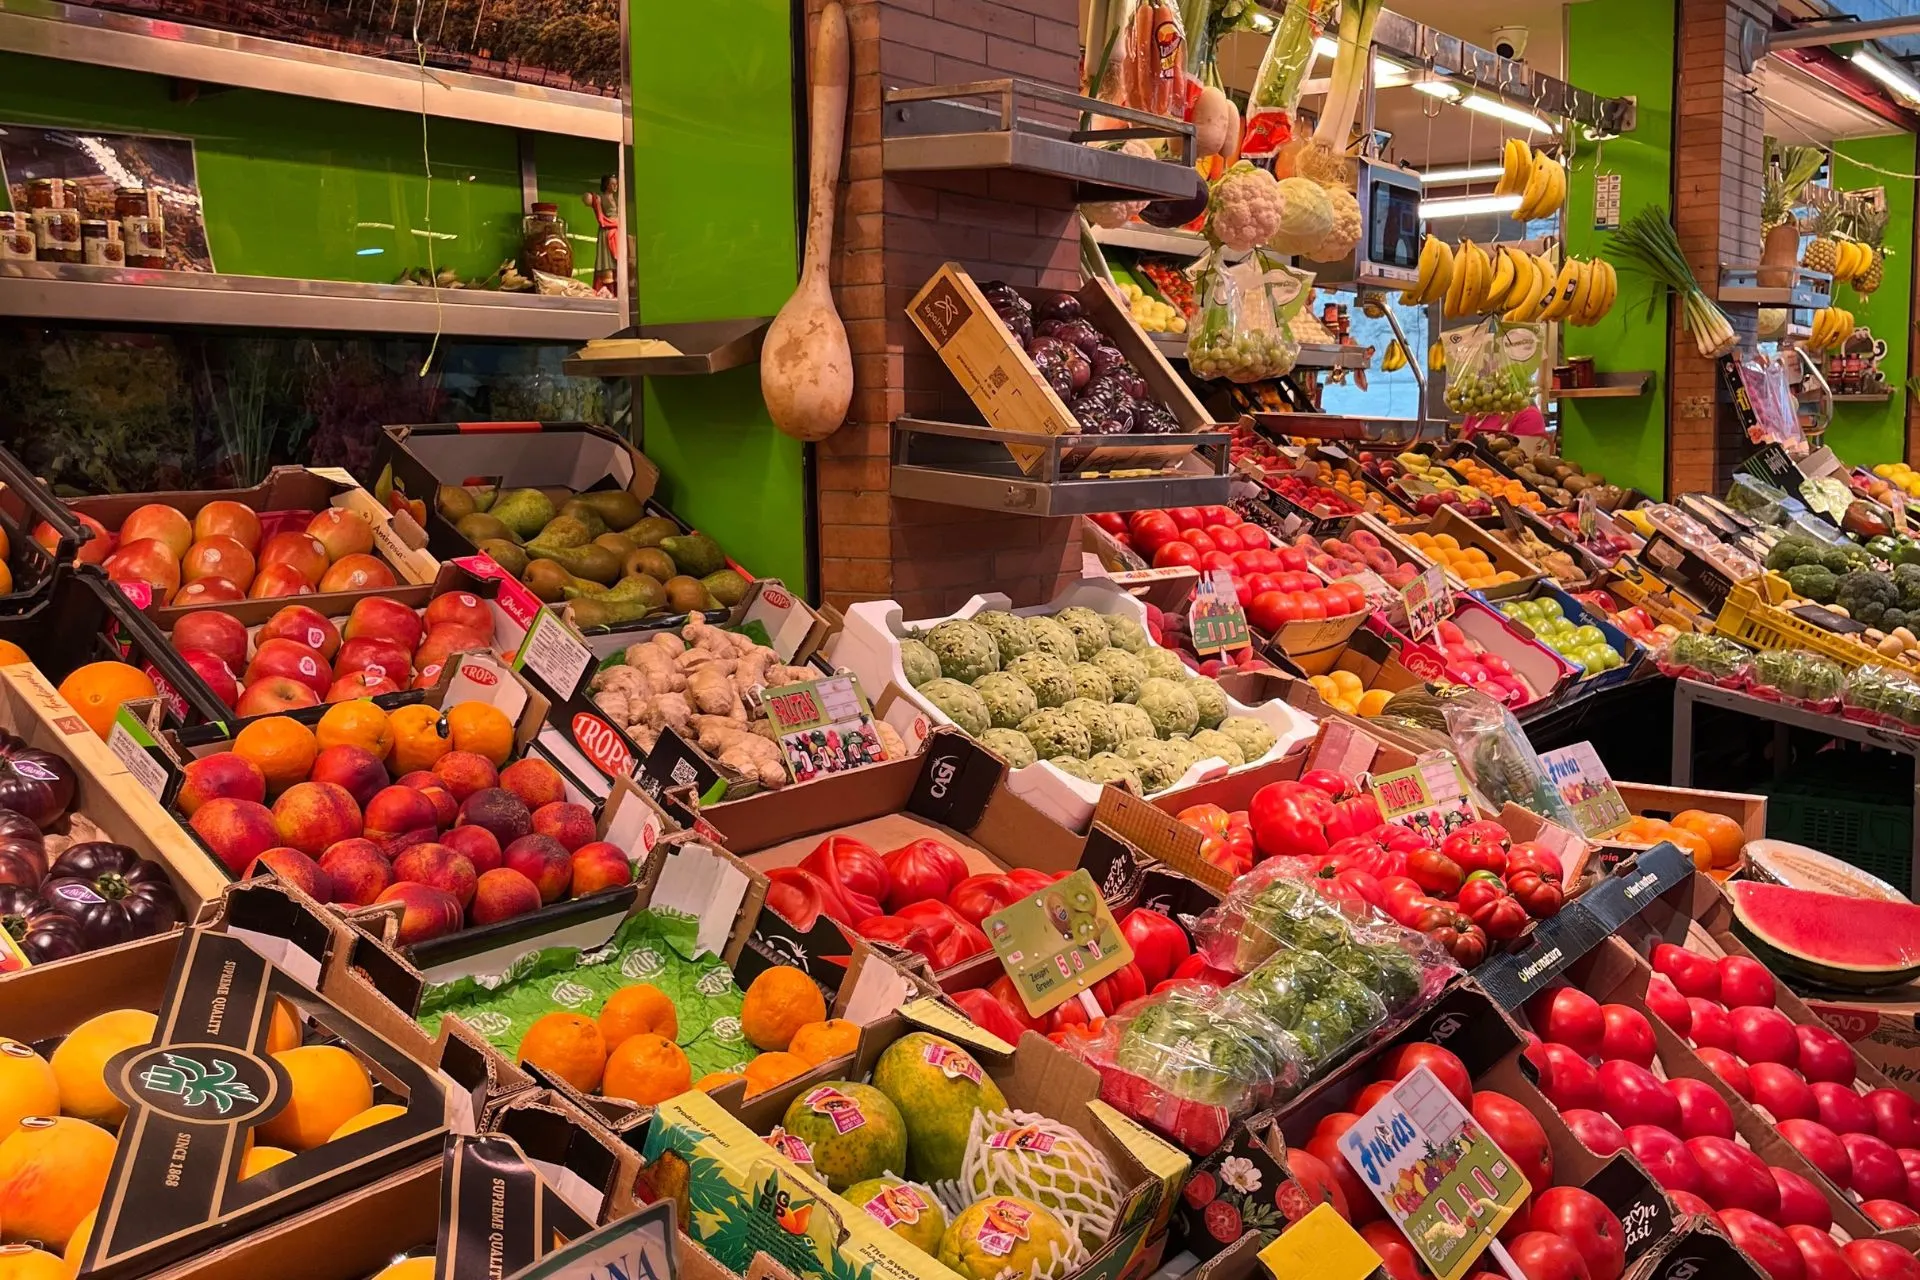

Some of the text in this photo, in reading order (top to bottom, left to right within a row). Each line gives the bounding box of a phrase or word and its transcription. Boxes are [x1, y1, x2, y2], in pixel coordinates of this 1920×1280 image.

[501, 595, 524, 617] Pink
[763, 591, 790, 609] TROPS
[462, 665, 498, 685] TROPS
[153, 676, 184, 709] Pink
[573, 715, 633, 777] TROPS
[930, 762, 957, 799] CASI
[1544, 752, 1581, 785] Frutas
[206, 960, 236, 1036] SUPREME QUALITY
[1035, 977, 1055, 993] Green
[673, 1105, 702, 1128] Product
[709, 1130, 730, 1149] Brazil
[164, 1132, 191, 1188] SINCE 1868
[490, 1177, 506, 1229] SUPREME
[588, 1247, 661, 1280] NA
[858, 1247, 898, 1277] BRAZILIAN
[867, 1242, 887, 1258] The
